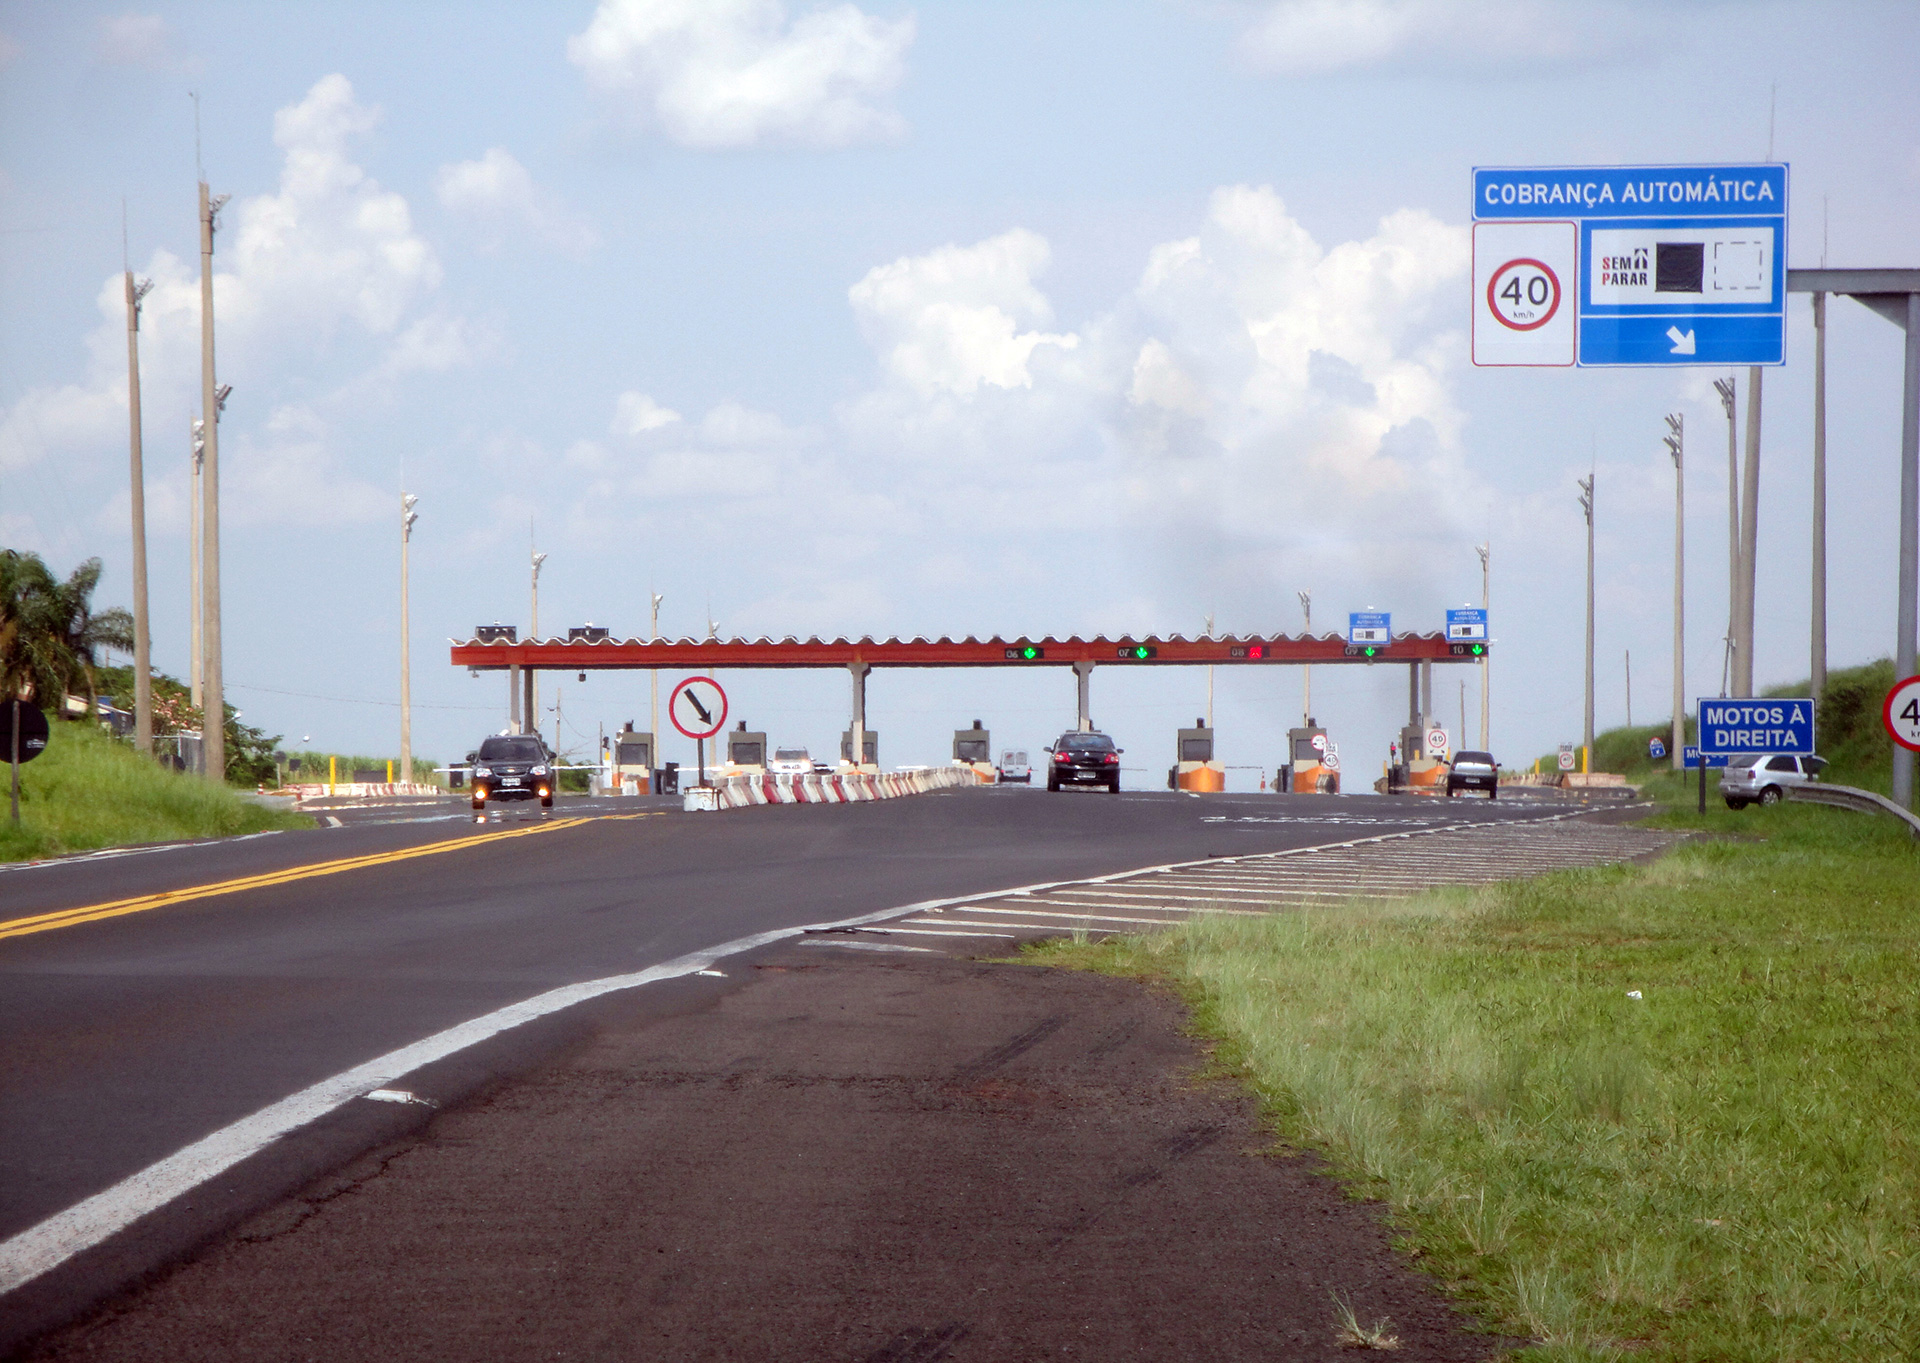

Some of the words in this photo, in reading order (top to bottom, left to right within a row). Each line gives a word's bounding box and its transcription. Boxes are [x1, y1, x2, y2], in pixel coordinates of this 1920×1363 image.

[1485, 183, 1615, 208] COBRANÇA
[1621, 175, 1774, 202] AUTOMÁTICA
[1602, 256, 1632, 270] SEM
[1602, 272, 1648, 286] PARAR
[1501, 276, 1549, 306] 40
[1513, 310, 1535, 319] km/h
[1118, 648, 1130, 657] 07
[1453, 646, 1464, 655] 10
[1707, 707, 1784, 725] MOTOS
[1789, 703, 1806, 725] À
[1432, 735, 1444, 743] 40
[1715, 729, 1799, 747] DIREITA
